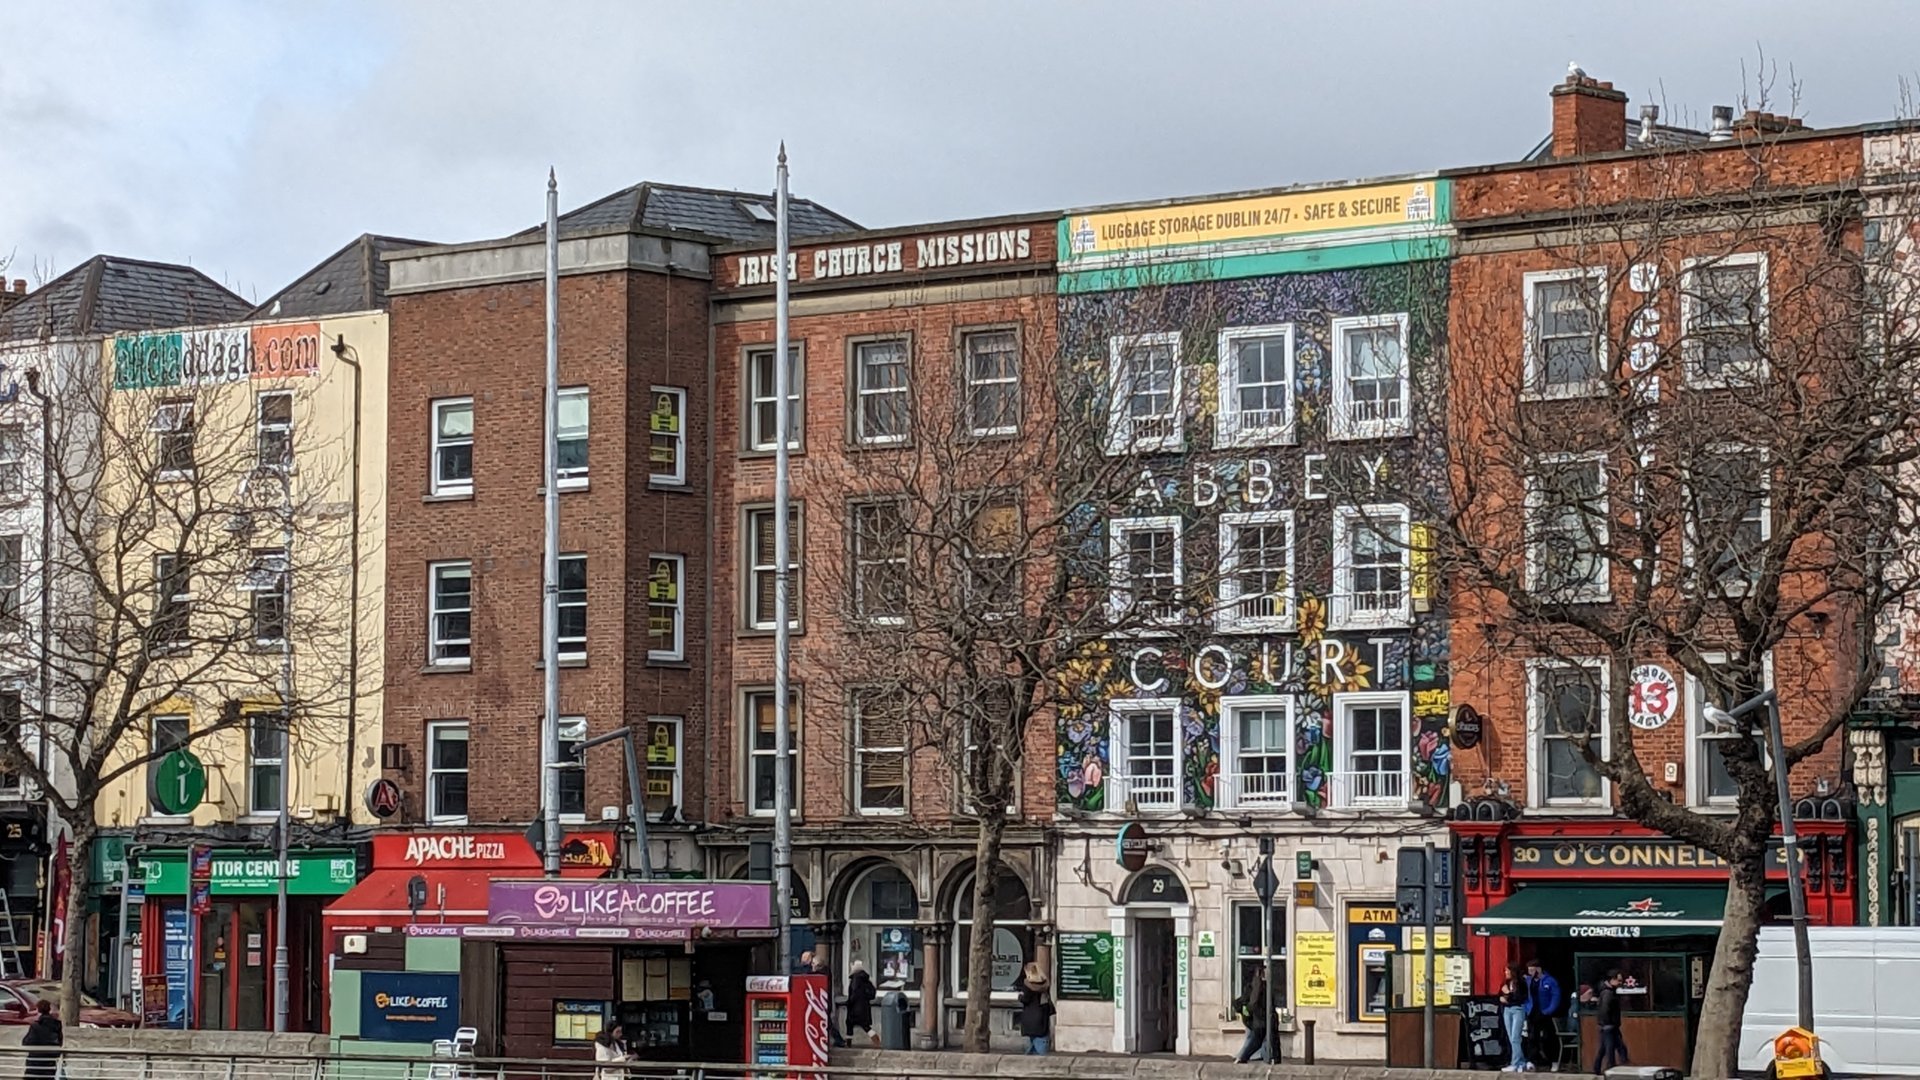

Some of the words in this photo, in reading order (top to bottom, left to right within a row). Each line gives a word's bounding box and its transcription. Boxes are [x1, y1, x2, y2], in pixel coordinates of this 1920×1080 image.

[1102, 220, 1156, 241] LUGGAGE
[1159, 214, 1213, 236] STORAGE
[1216, 210, 1261, 229] DUBLIN
[1264, 207, 1291, 225] 24/7
[1304, 201, 1336, 221] SAFE
[1338, 200, 1349, 218] &
[1351, 195, 1401, 216] SECURE
[738, 253, 797, 286] IRISH
[815, 242, 903, 279] CHURCH
[917, 228, 1031, 269] MISSIONS
[1134, 453, 1384, 508] ABBEY
[1130, 636, 1394, 691] COURT
[1632, 682, 1670, 714] 13
[404, 836, 475, 866] APACHE
[476, 843, 505, 859] PIZZA
[1514, 847, 1540, 863] 30
[212, 860, 244, 876] ITOR
[1153, 879, 1165, 893] 29
[1363, 910, 1393, 921] ATM
[1570, 926, 1641, 938] O'CONNELL'S
[1115, 937, 1124, 1009] HOSTEL
[1178, 937, 1187, 1010] HOSTEL
